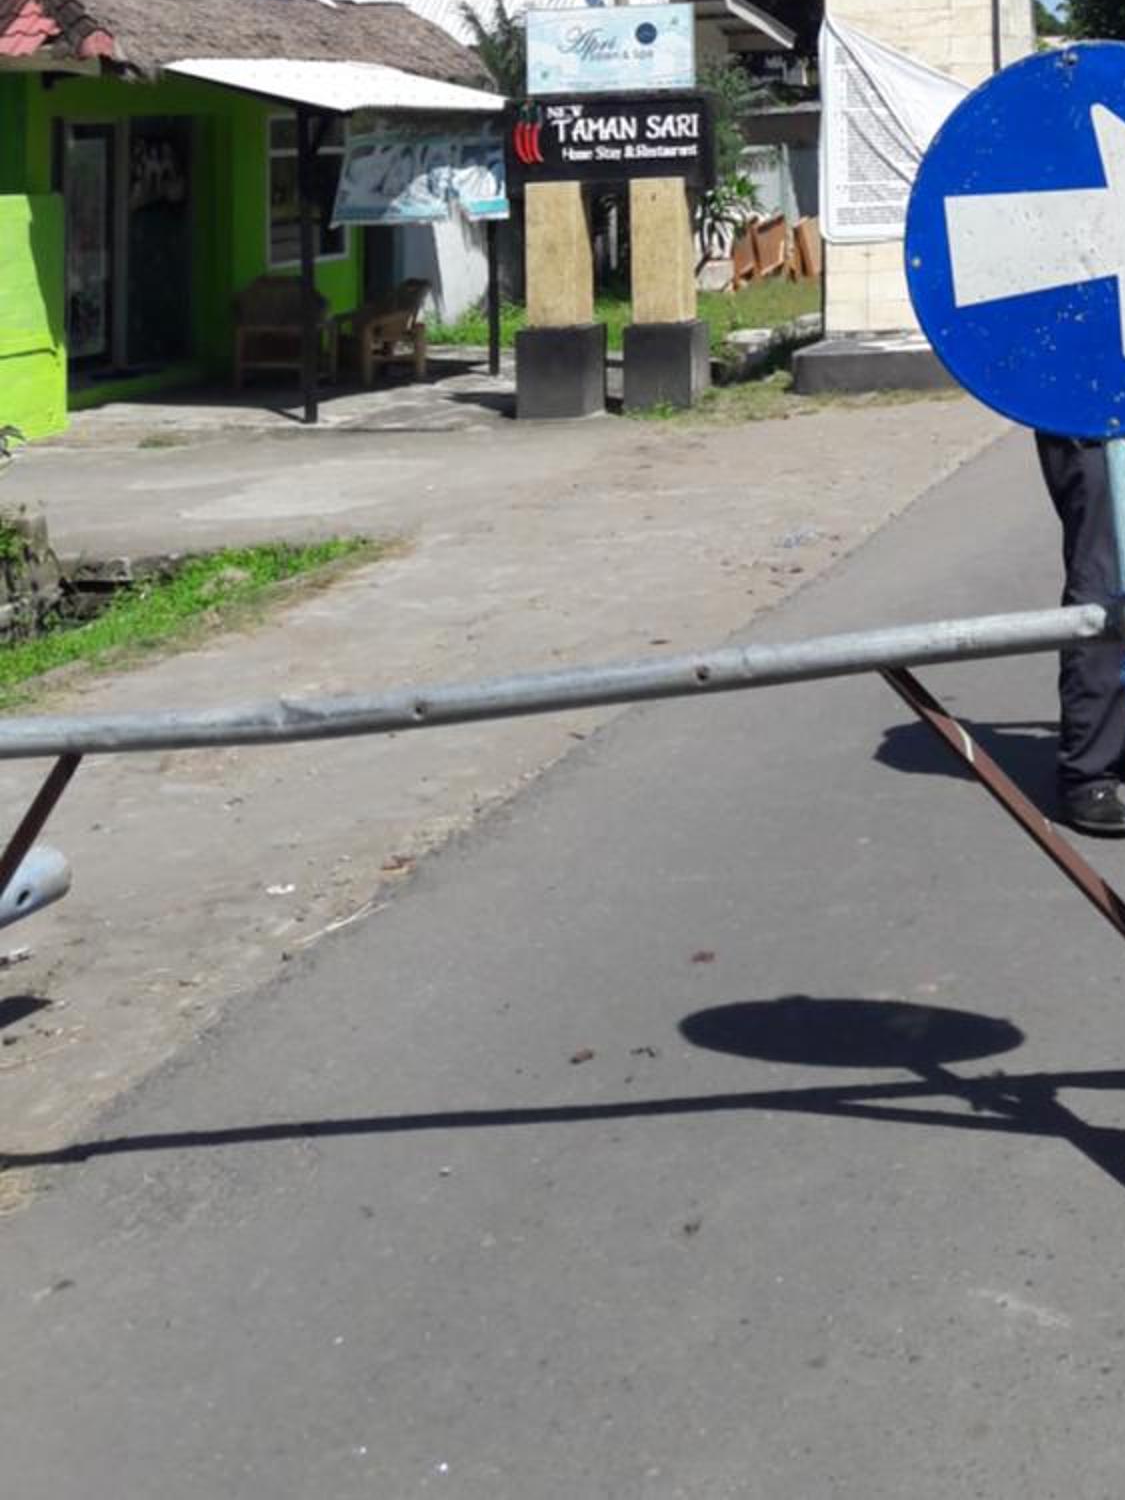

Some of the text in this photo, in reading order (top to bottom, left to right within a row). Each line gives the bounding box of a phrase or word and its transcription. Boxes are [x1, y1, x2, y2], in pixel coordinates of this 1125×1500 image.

[546, 104, 583, 119] NEW
[552, 112, 699, 143] TAMAN SARI
